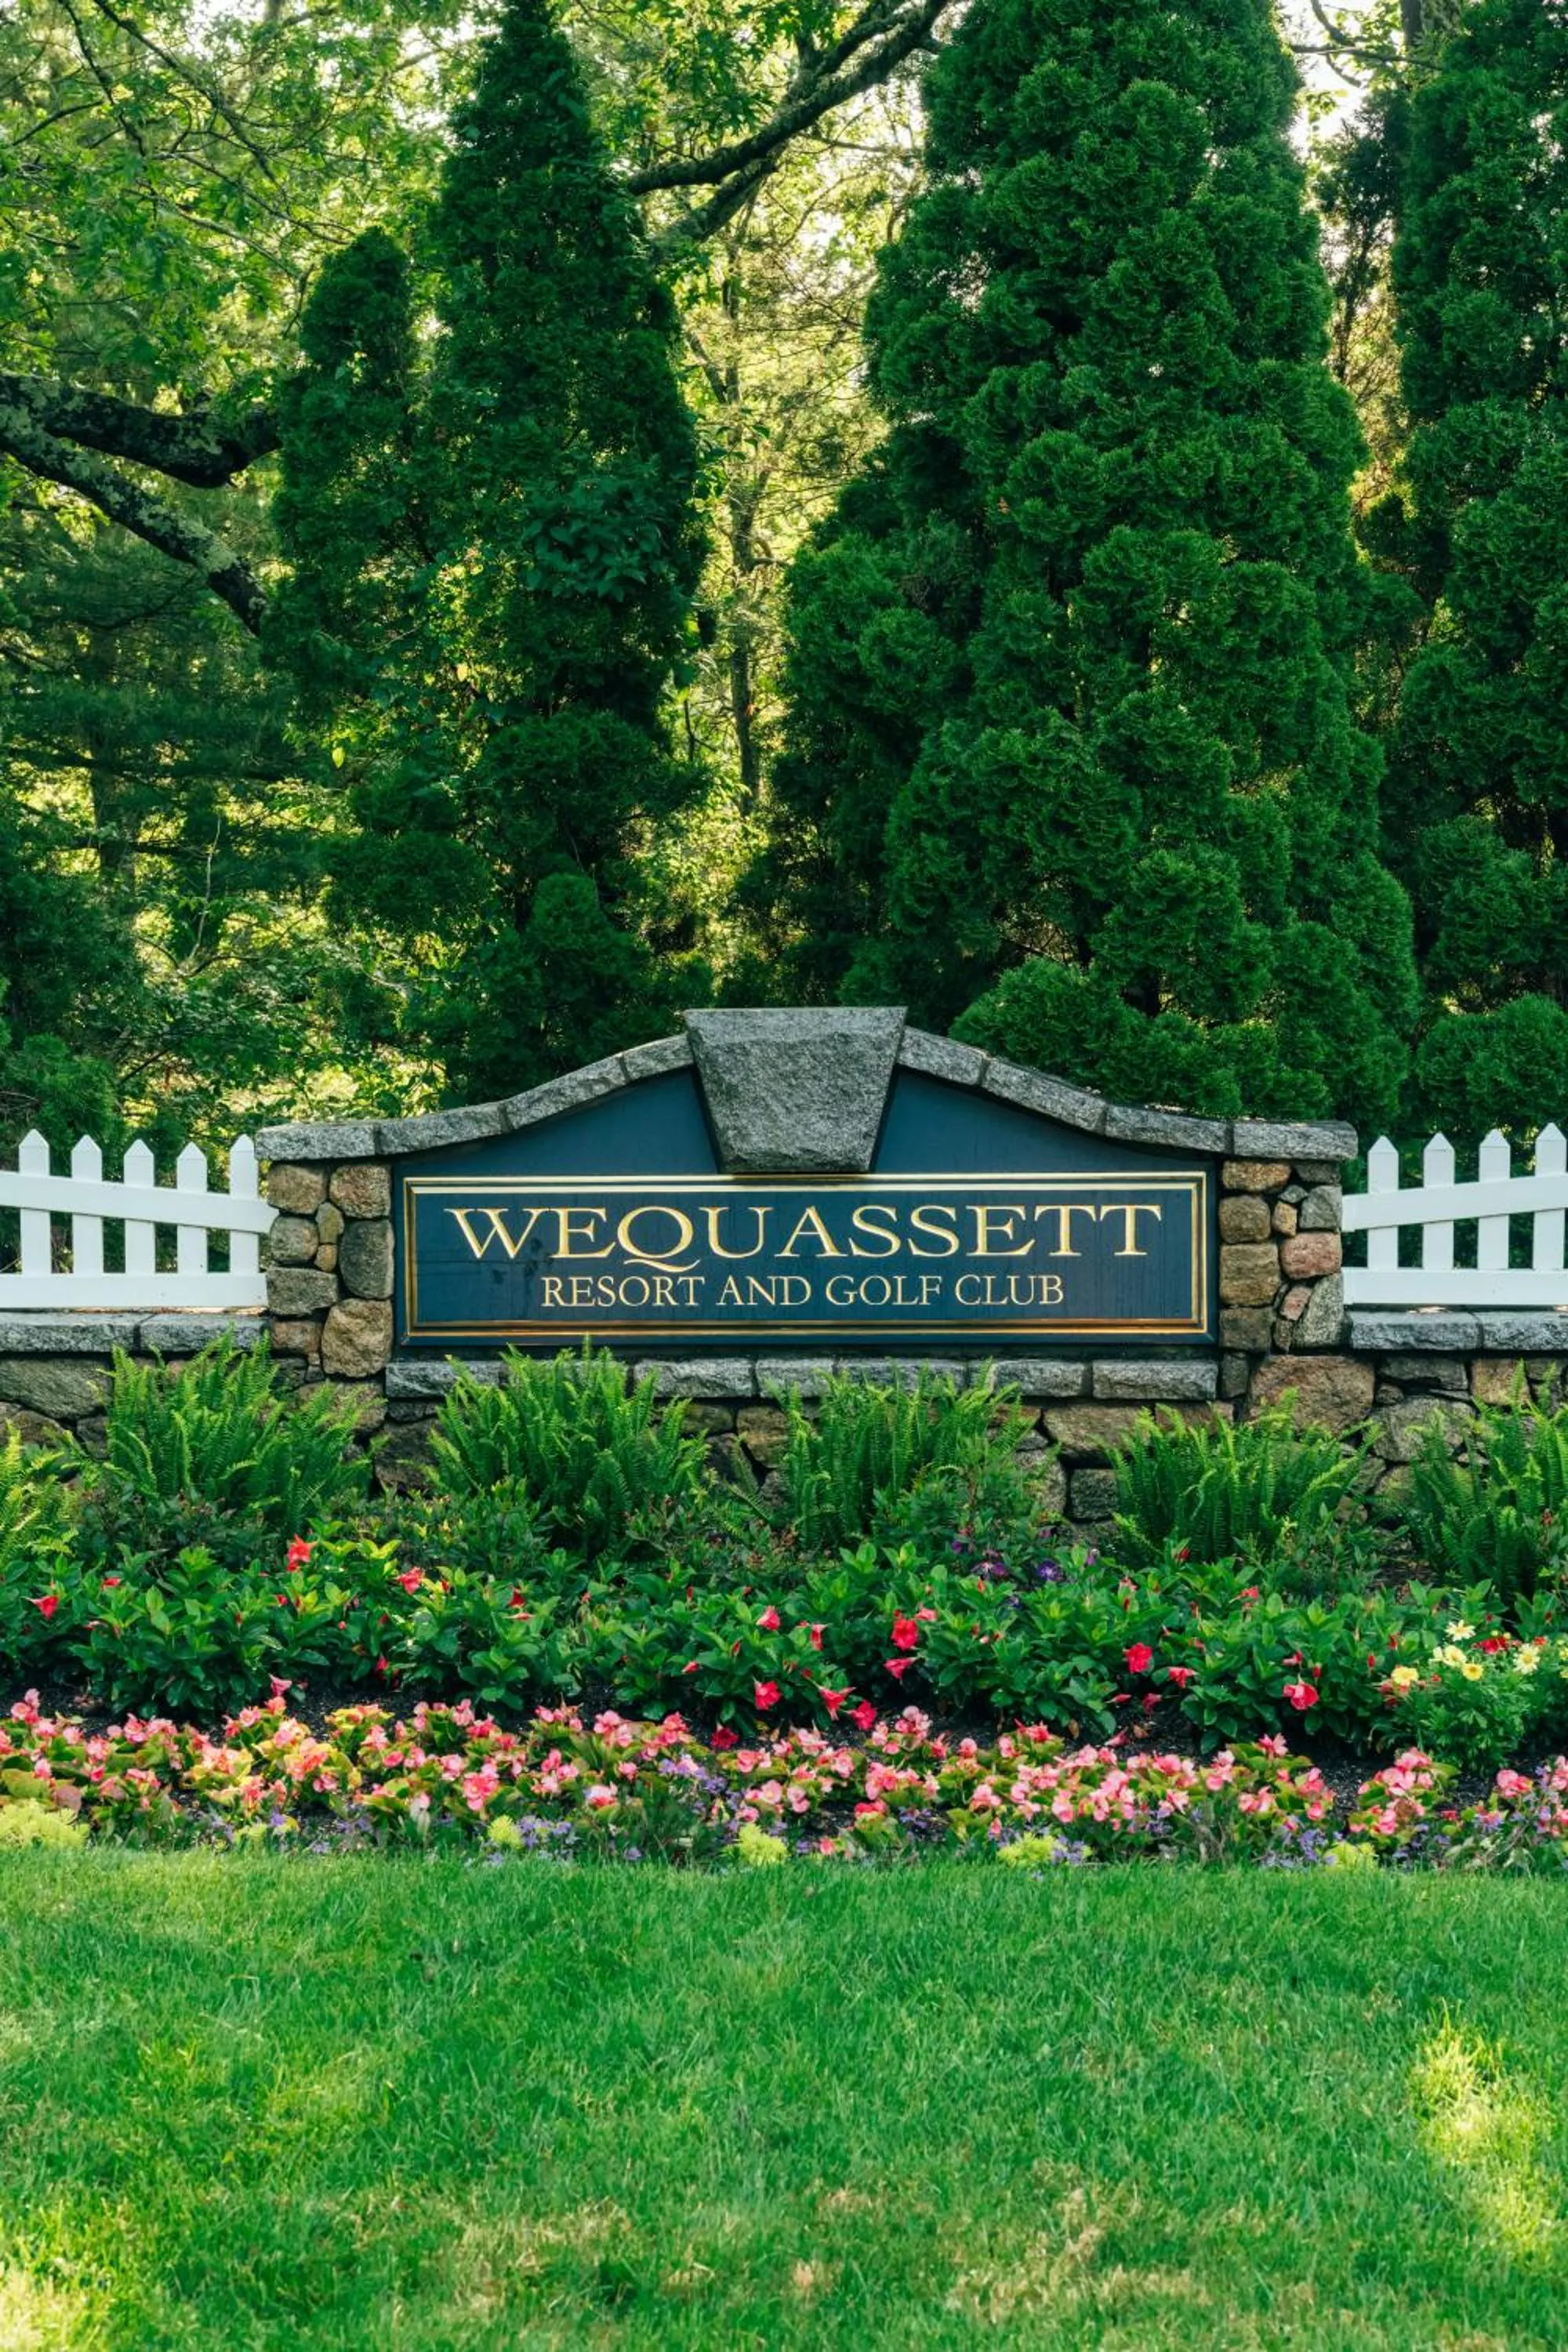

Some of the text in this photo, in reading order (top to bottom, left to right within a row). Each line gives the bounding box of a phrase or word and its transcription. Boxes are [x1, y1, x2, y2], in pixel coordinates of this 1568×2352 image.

[444, 1204, 1162, 1272] WEQUASSETT
[540, 1275, 1064, 1306] RESORT AND GOLF CLUB
